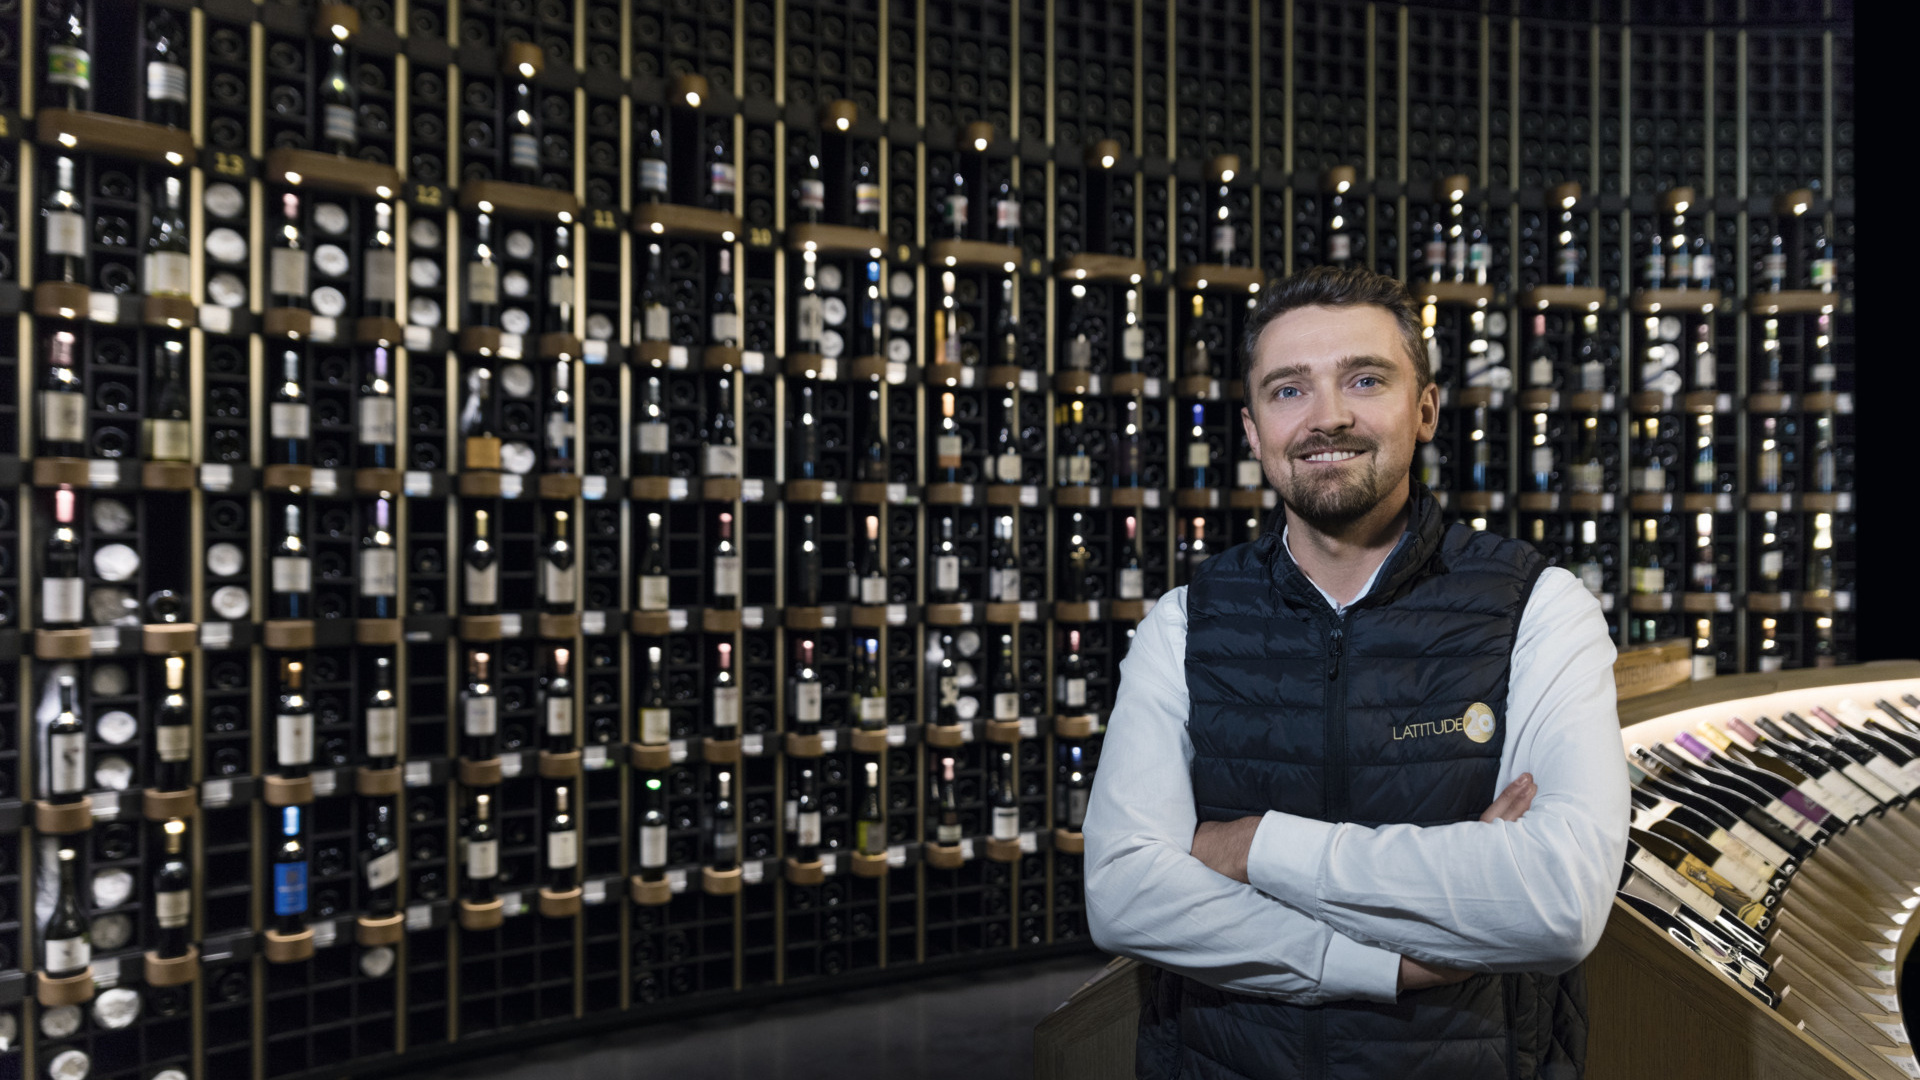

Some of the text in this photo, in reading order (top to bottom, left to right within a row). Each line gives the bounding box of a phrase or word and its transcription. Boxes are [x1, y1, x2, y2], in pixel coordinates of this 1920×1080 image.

[215, 152, 244, 175] 13
[416, 184, 441, 206] 12
[594, 209, 616, 229] 11
[1393, 717, 1463, 740] LATITUDE
